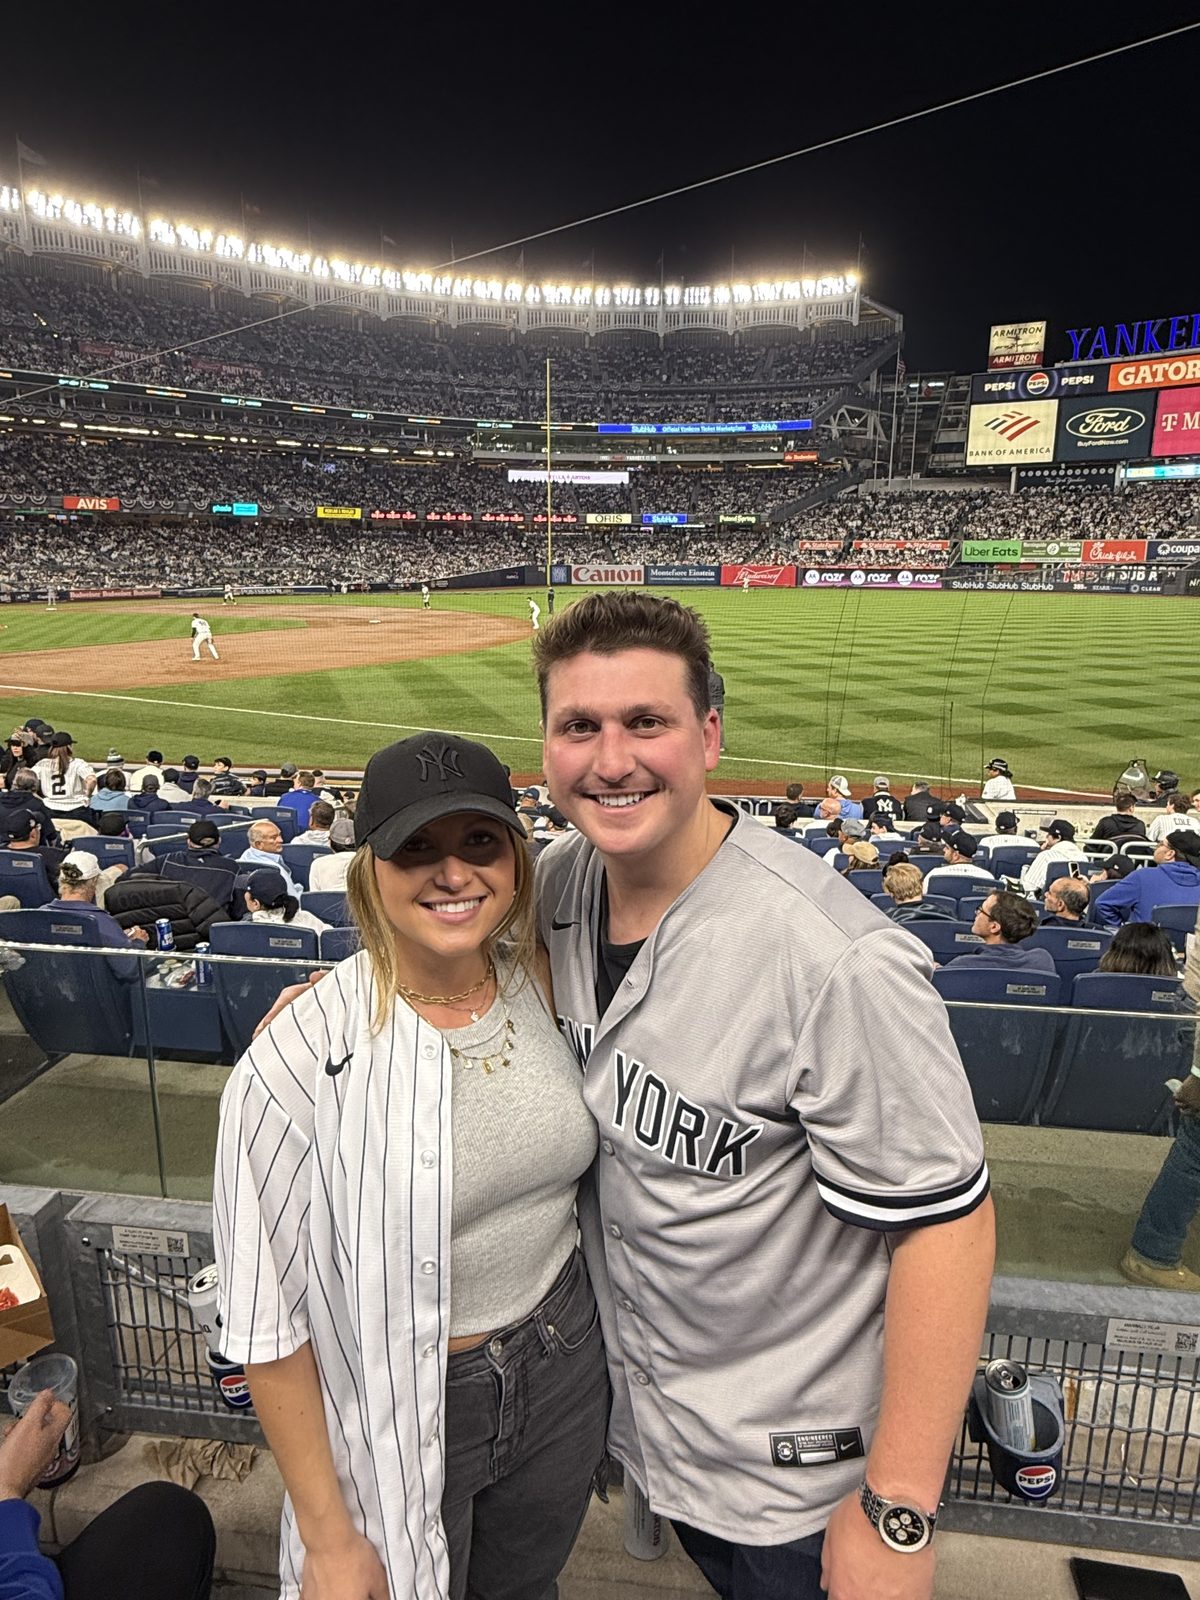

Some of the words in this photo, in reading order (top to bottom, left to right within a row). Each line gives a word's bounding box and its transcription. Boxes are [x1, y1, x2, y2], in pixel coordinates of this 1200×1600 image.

[993, 326, 1043, 338] ARMITRON
[114, 350, 138, 361] PARTY
[992, 353, 1038, 364] ARMITRON
[1118, 359, 1200, 386] GATOR
[984, 381, 1016, 392] PEPSI
[1061, 375, 1094, 386] PEPSI
[631, 424, 657, 433] StubHub
[752, 423, 778, 431] StubHub
[1079, 412, 1132, 434] Ford
[1161, 413, 1178, 432] T
[969, 449, 994, 457] BANK
[995, 448, 1007, 456] OF
[1009, 446, 1051, 456] AMERICA
[77, 498, 106, 510] AVIS
[595, 514, 623, 523] ORIS
[652, 515, 678, 523] StubHub
[964, 546, 990, 557] Uber
[992, 546, 1018, 557] Eats
[1170, 543, 1200, 556] coupa
[572, 566, 643, 583] Canon
[650, 568, 687, 577] Montefiore
[688, 568, 715, 577] Einstein
[821, 572, 845, 582] razr
[867, 572, 892, 583] razr
[914, 573, 940, 584] razr
[952, 580, 984, 589] StubHub
[986, 581, 1019, 590] StubHub
[1021, 582, 1054, 591] StubHub
[415, 742, 465, 782] NY
[51, 775, 66, 795] 2
[876, 798, 893, 812] NY
[1173, 817, 1191, 826] COLE
[612, 1047, 764, 1177] YORK
[222, 1384, 249, 1394] PEPS
[1018, 1474, 1054, 1485] PEPSI
